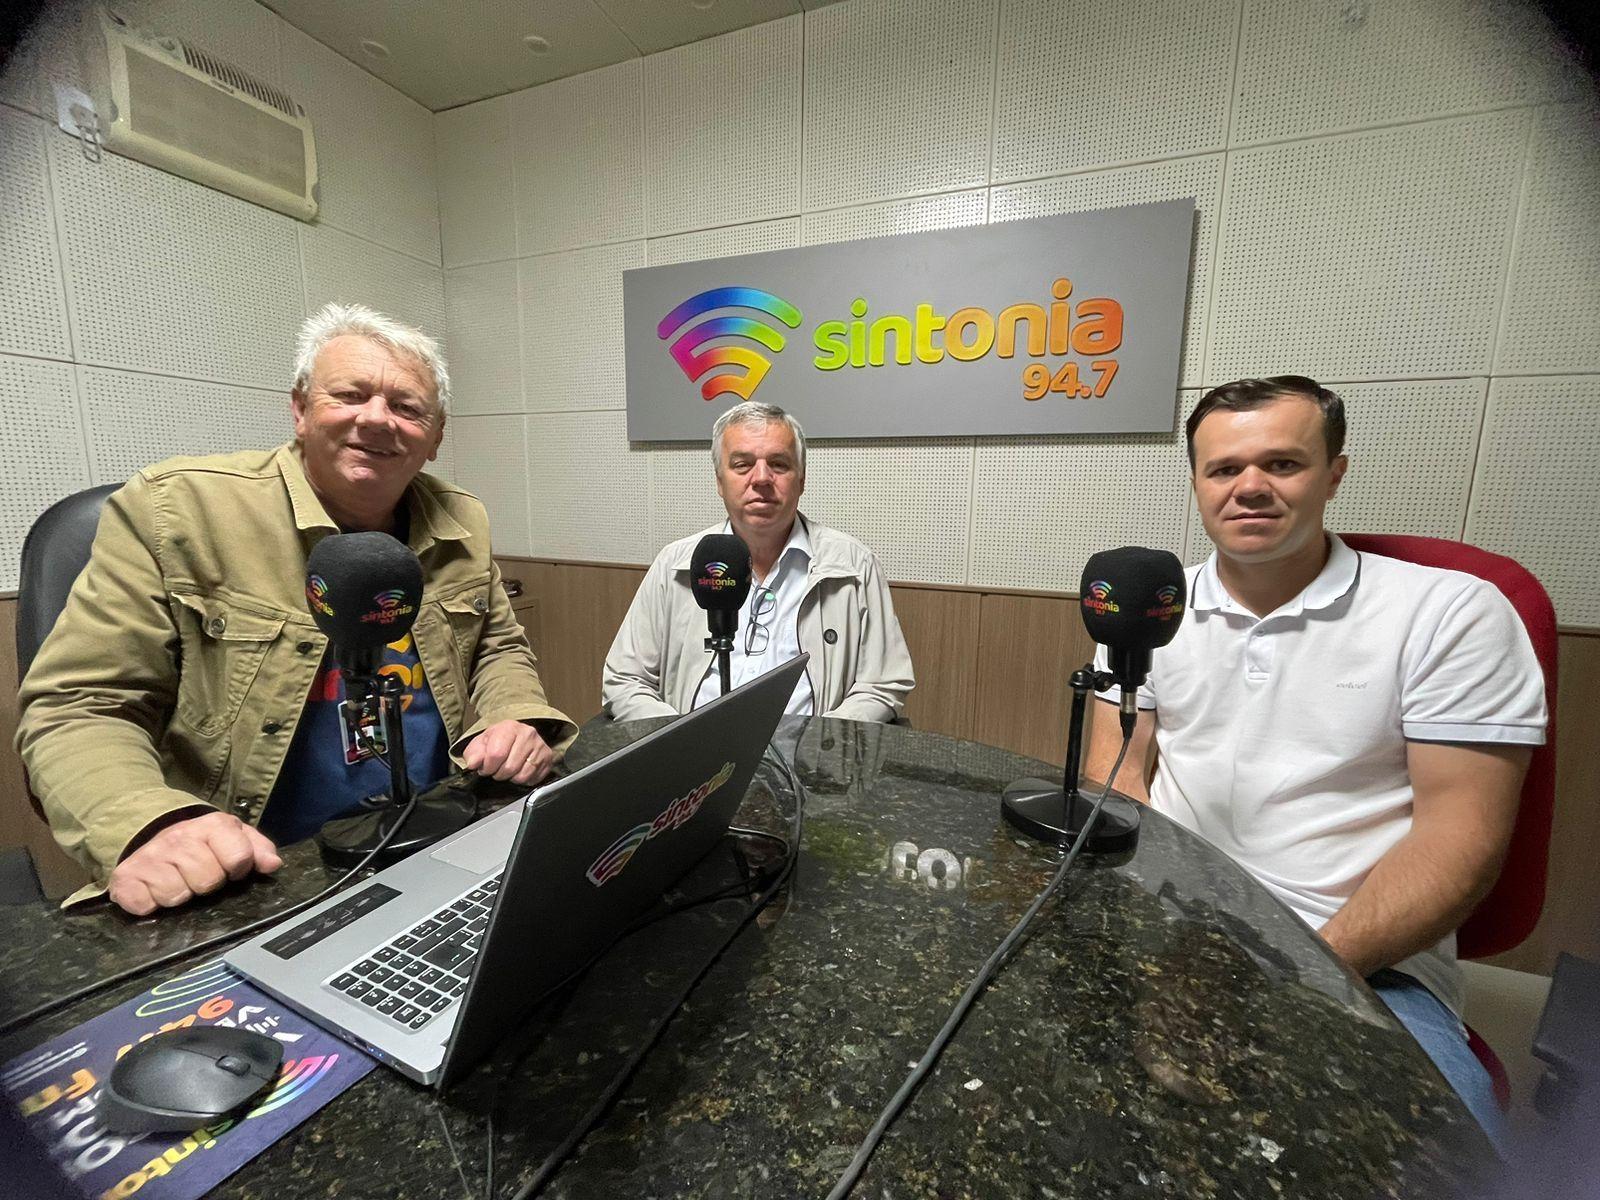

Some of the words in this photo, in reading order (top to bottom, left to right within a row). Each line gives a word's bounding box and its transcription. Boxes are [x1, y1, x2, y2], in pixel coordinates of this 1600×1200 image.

[813, 278, 1123, 369] sintonia
[1022, 359, 1119, 400] 94.7
[697, 576, 736, 586] sintonia
[360, 603, 413, 622] sintonia
[1084, 596, 1120, 613] sintonia
